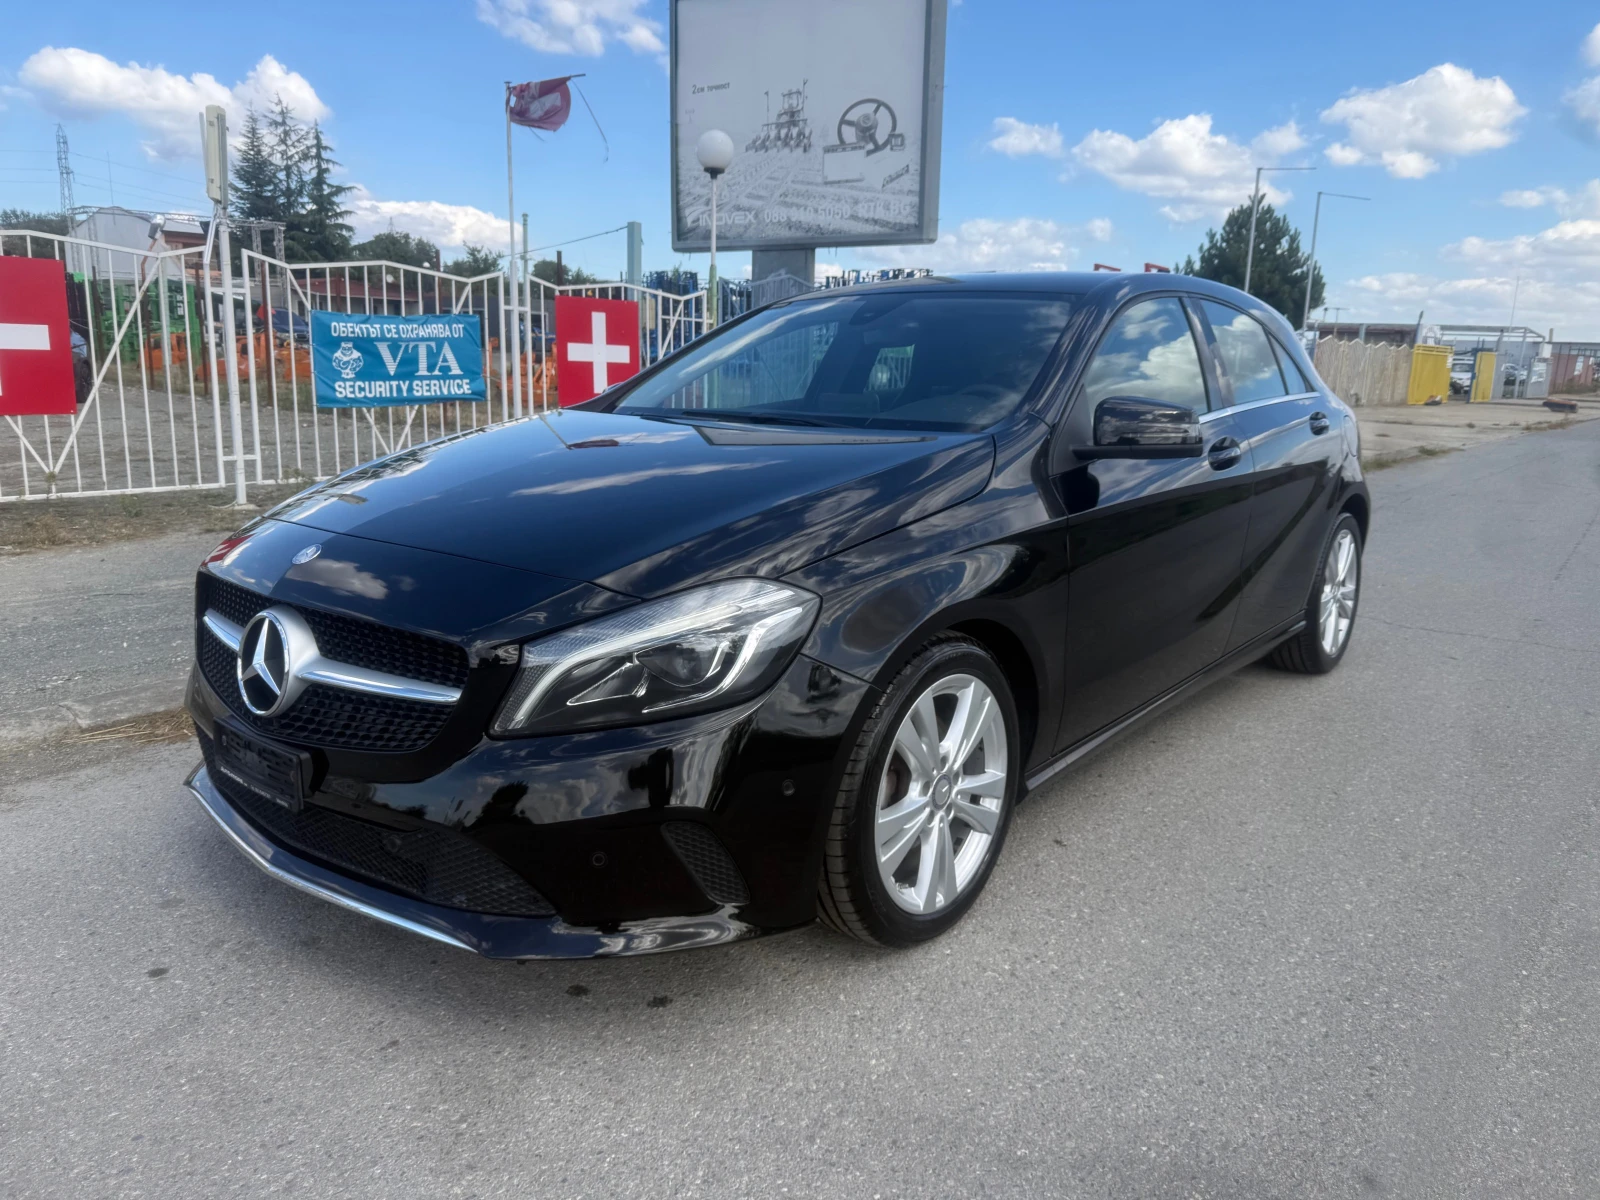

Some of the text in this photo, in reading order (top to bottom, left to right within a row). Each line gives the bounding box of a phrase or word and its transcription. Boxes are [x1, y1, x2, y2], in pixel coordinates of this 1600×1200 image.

[331, 321, 464, 338] ОБЕКТЪТ СЕ ОХРАНЯВА ОТ
[373, 341, 464, 376] VTA
[334, 379, 472, 398] SECURITY SERVICE
